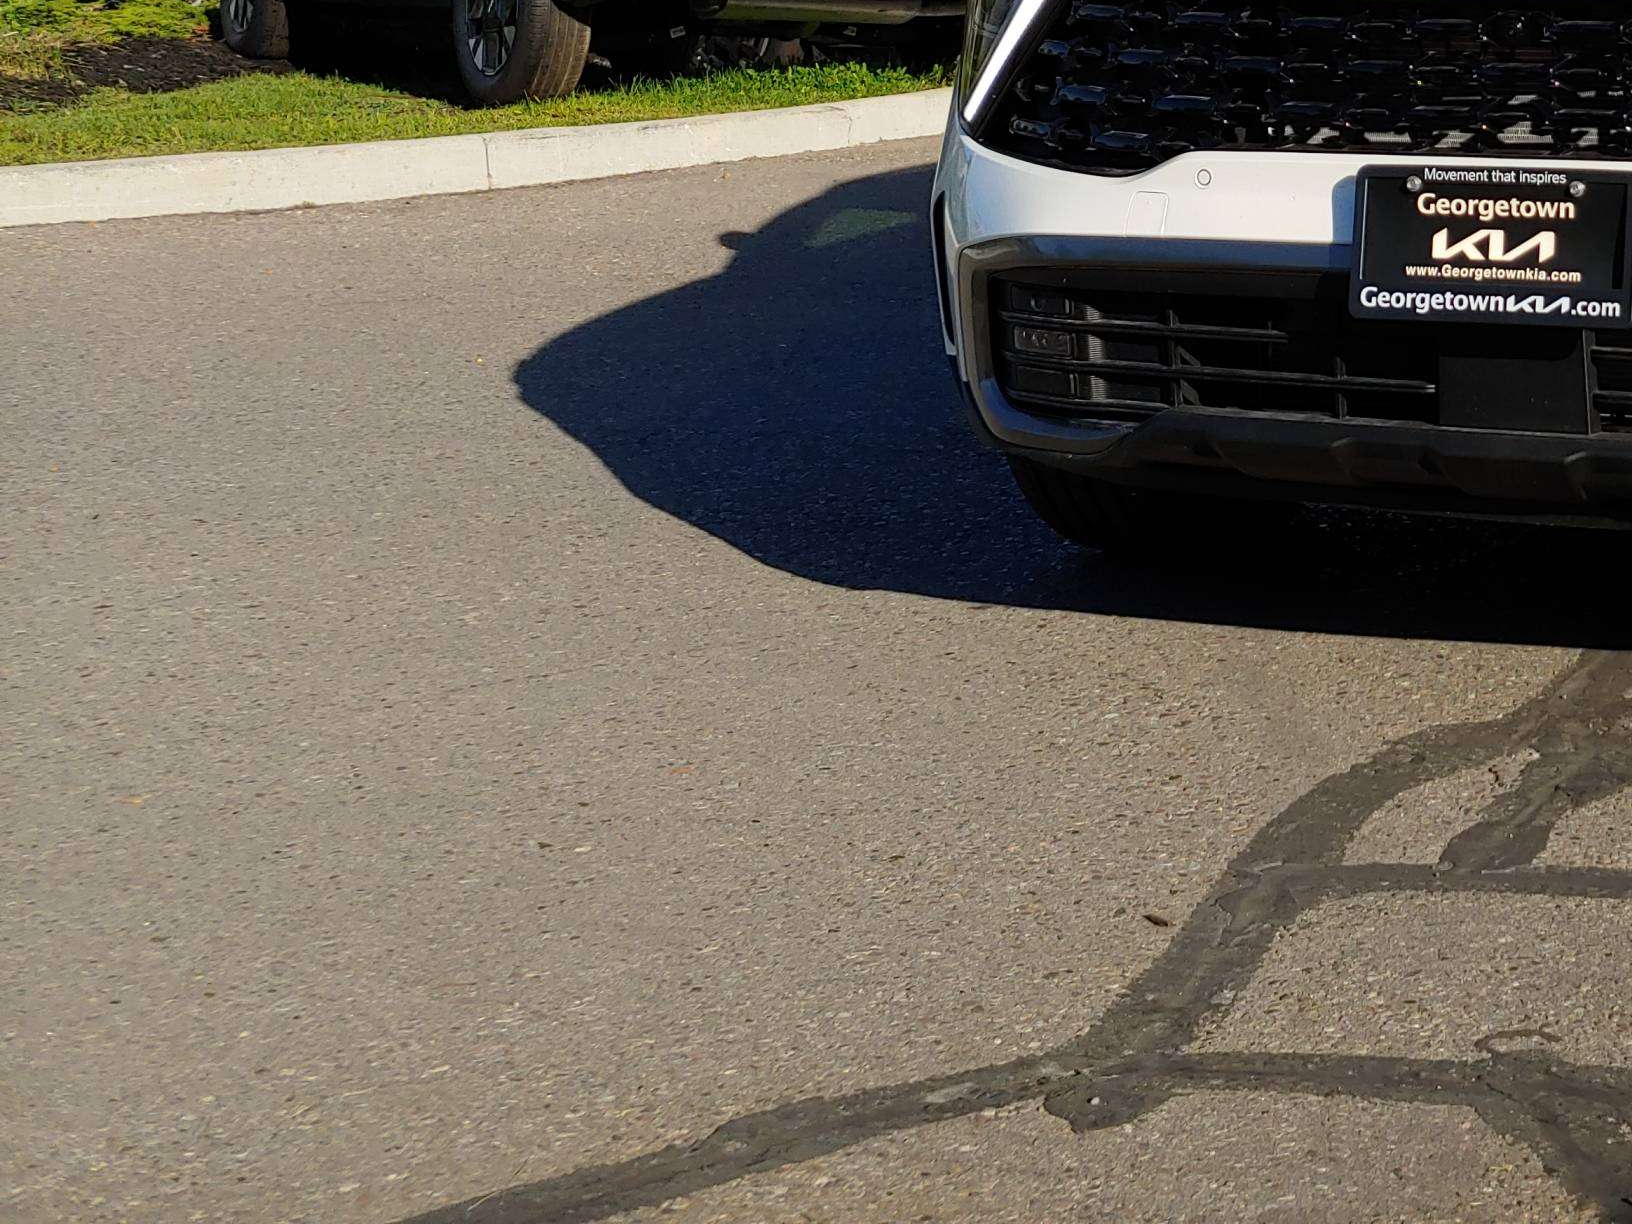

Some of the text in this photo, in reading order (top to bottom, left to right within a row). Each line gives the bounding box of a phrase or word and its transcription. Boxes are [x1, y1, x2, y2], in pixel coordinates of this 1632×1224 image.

[1424, 167, 1567, 186] Movement that inspires
[1417, 192, 1576, 221] Georgetown
[1432, 227, 1556, 264] KIA
[1405, 264, 1582, 282] www.Georgetownkia.com
